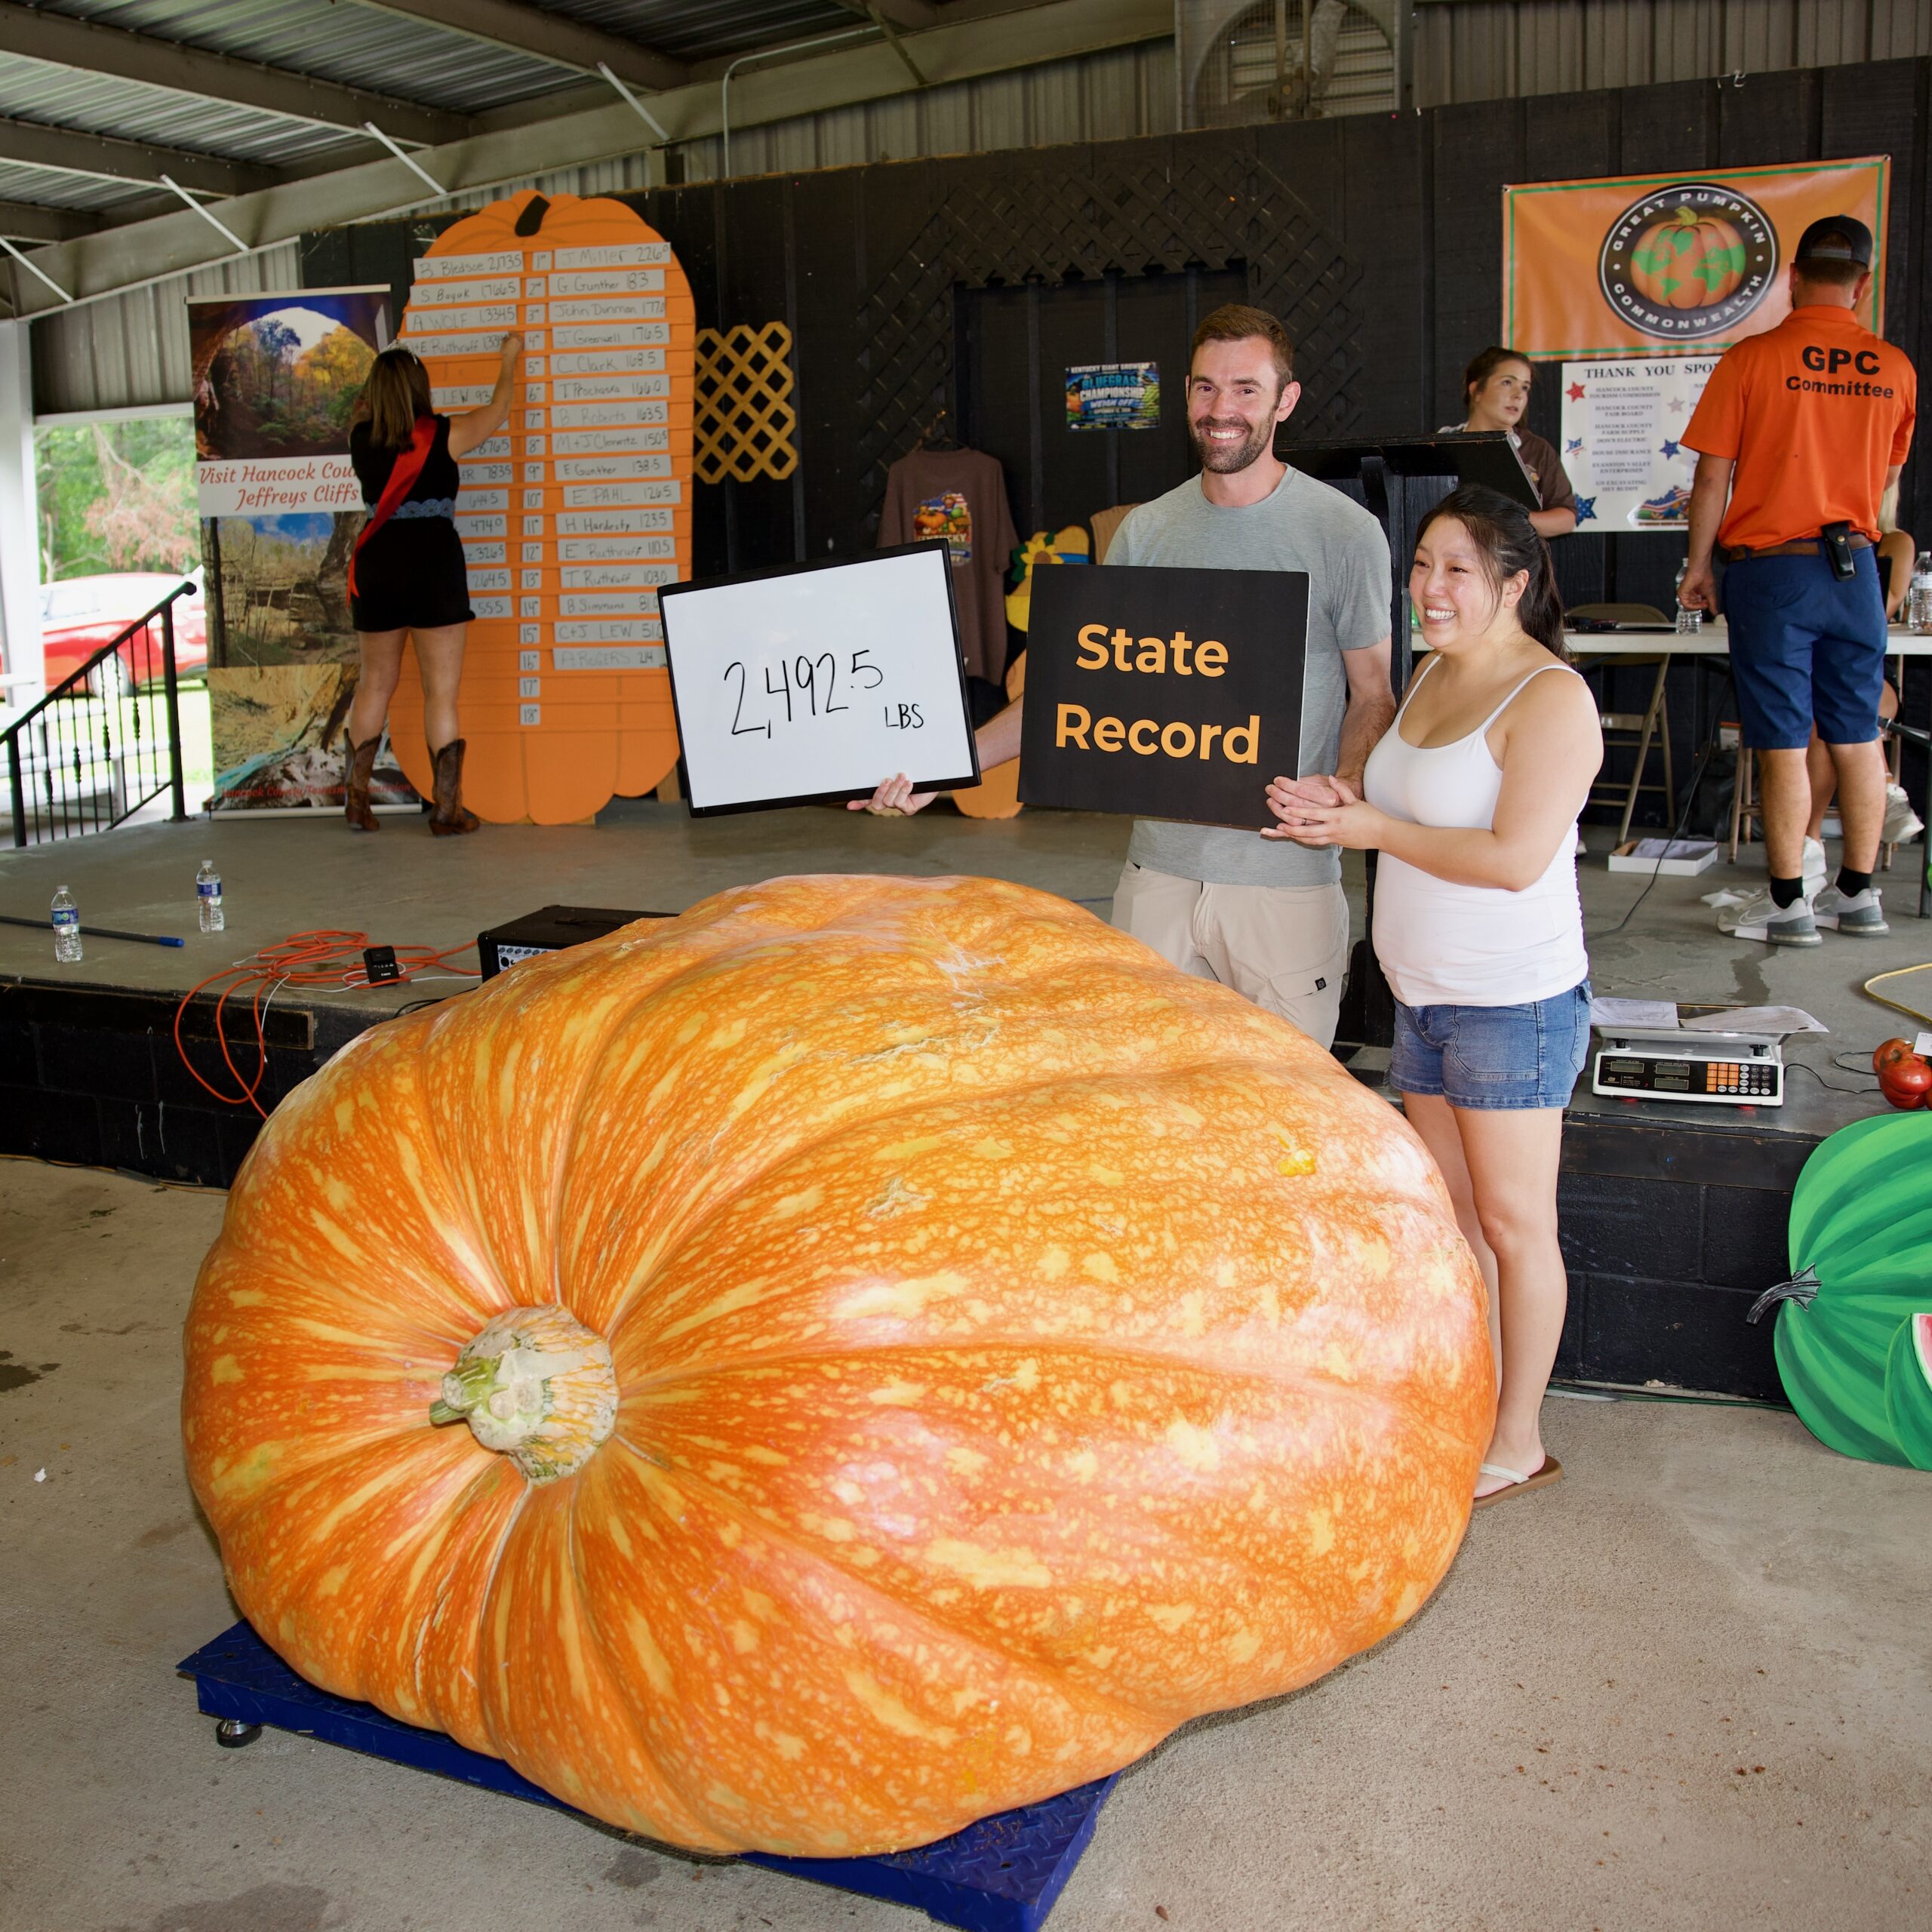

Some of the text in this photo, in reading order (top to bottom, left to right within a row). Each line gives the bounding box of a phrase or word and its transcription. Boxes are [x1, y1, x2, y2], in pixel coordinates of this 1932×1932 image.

[1613, 192, 1766, 251] GREAT PUMPKIN
[580, 248, 628, 264] Miller
[558, 276, 568, 293] G
[574, 275, 620, 292] Gunther
[421, 289, 430, 303] S
[1614, 275, 1762, 329] COMMONWEALTH
[412, 314, 423, 331] A
[429, 312, 469, 331] WOLF
[557, 355, 575, 374] C
[577, 355, 619, 374] Clark
[1802, 346, 1880, 375] GPC
[1585, 363, 1717, 378] THANK YOU SPO
[1080, 386, 1145, 401] CHAMPIONSHIP
[1786, 376, 1894, 398] Committee
[442, 388, 469, 406] LEW
[580, 407, 626, 425] Roberts
[199, 461, 358, 485] Visit Hancock Cou
[574, 463, 617, 477] Gunther
[235, 482, 359, 511] Jeffreys Cliffs
[591, 485, 632, 504] PAHL
[565, 516, 577, 532] H
[565, 542, 580, 559] E
[566, 598, 575, 614] B
[598, 622, 633, 640] LEW
[1075, 623, 1229, 678] State
[724, 649, 883, 739] 2,492.5
[884, 703, 924, 730] LBS
[1055, 703, 1260, 764] Record
